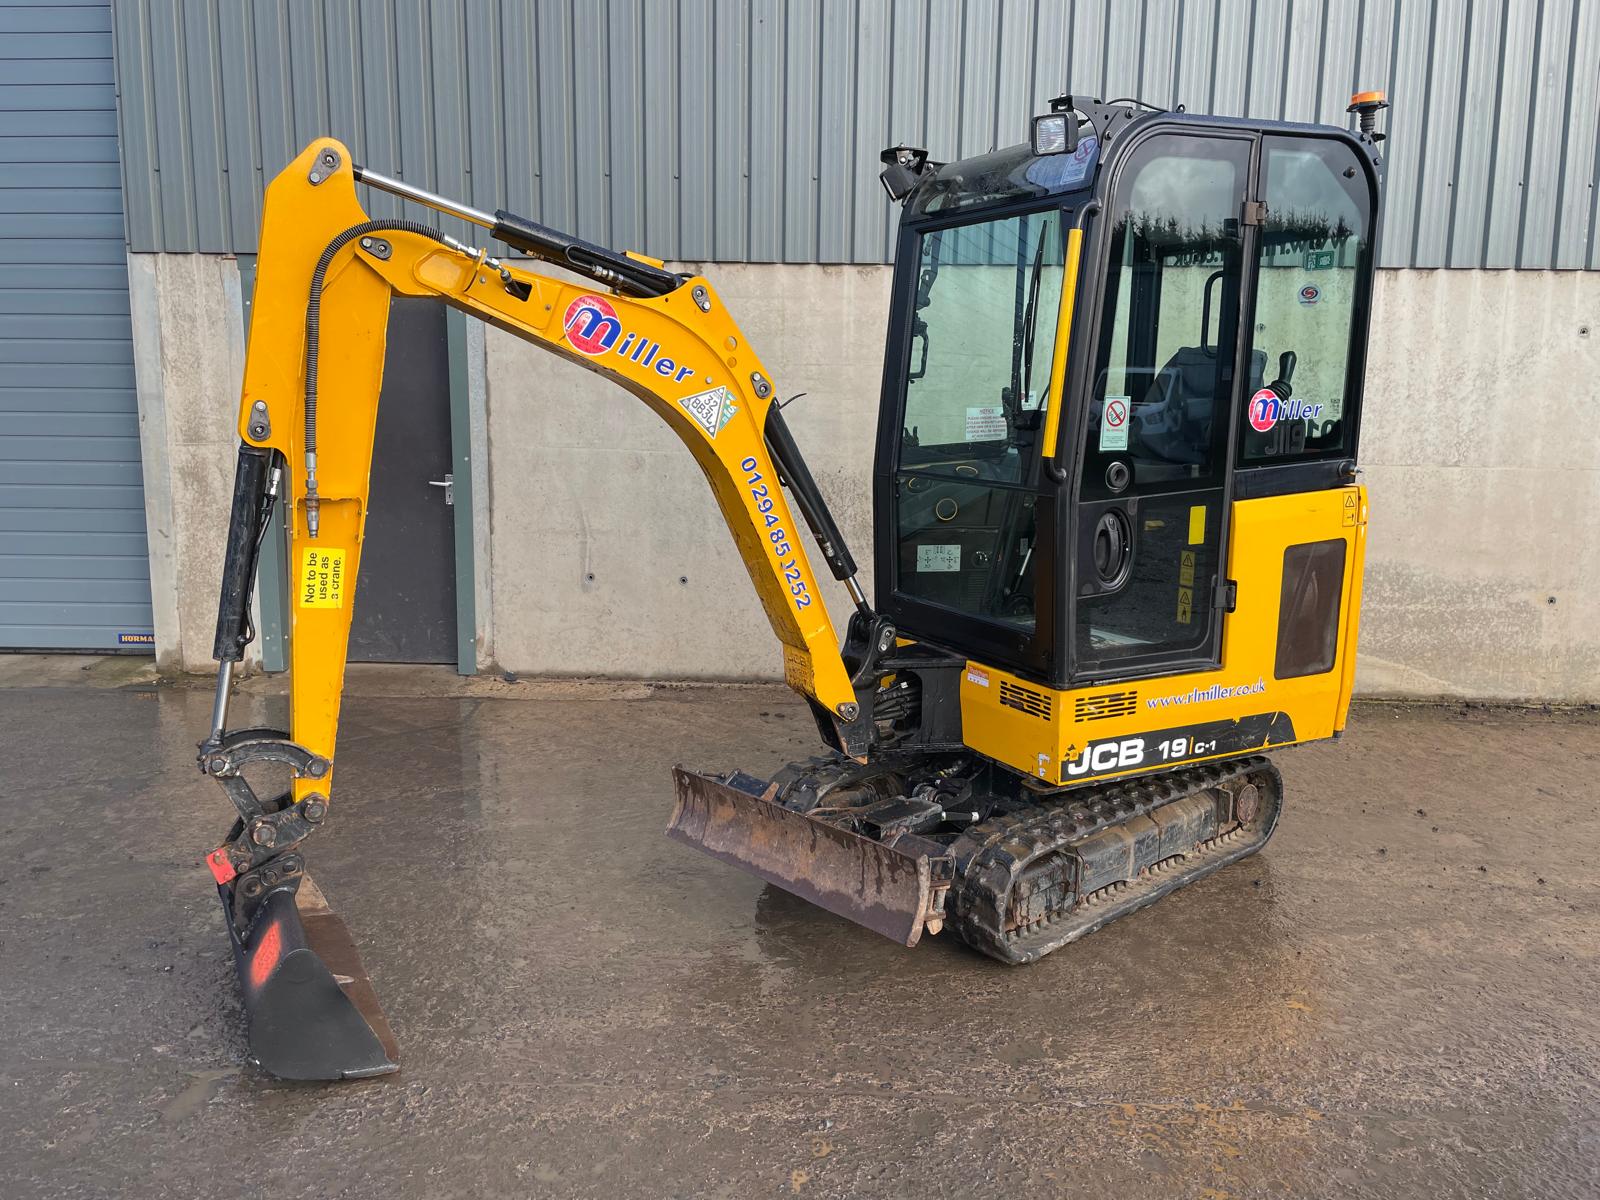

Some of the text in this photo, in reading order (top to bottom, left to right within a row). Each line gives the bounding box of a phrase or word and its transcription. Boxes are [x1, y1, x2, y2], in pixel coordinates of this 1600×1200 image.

[703, 394, 718, 412] 32
[740, 456, 780, 528] 01294
[304, 552, 318, 603] Not to be
[319, 556, 330, 600] used as
[332, 557, 342, 590] crane.
[1147, 677, 1265, 709] www.rlmiller.co.uk
[1068, 738, 1145, 775] JCB
[1159, 738, 1187, 760] 19
